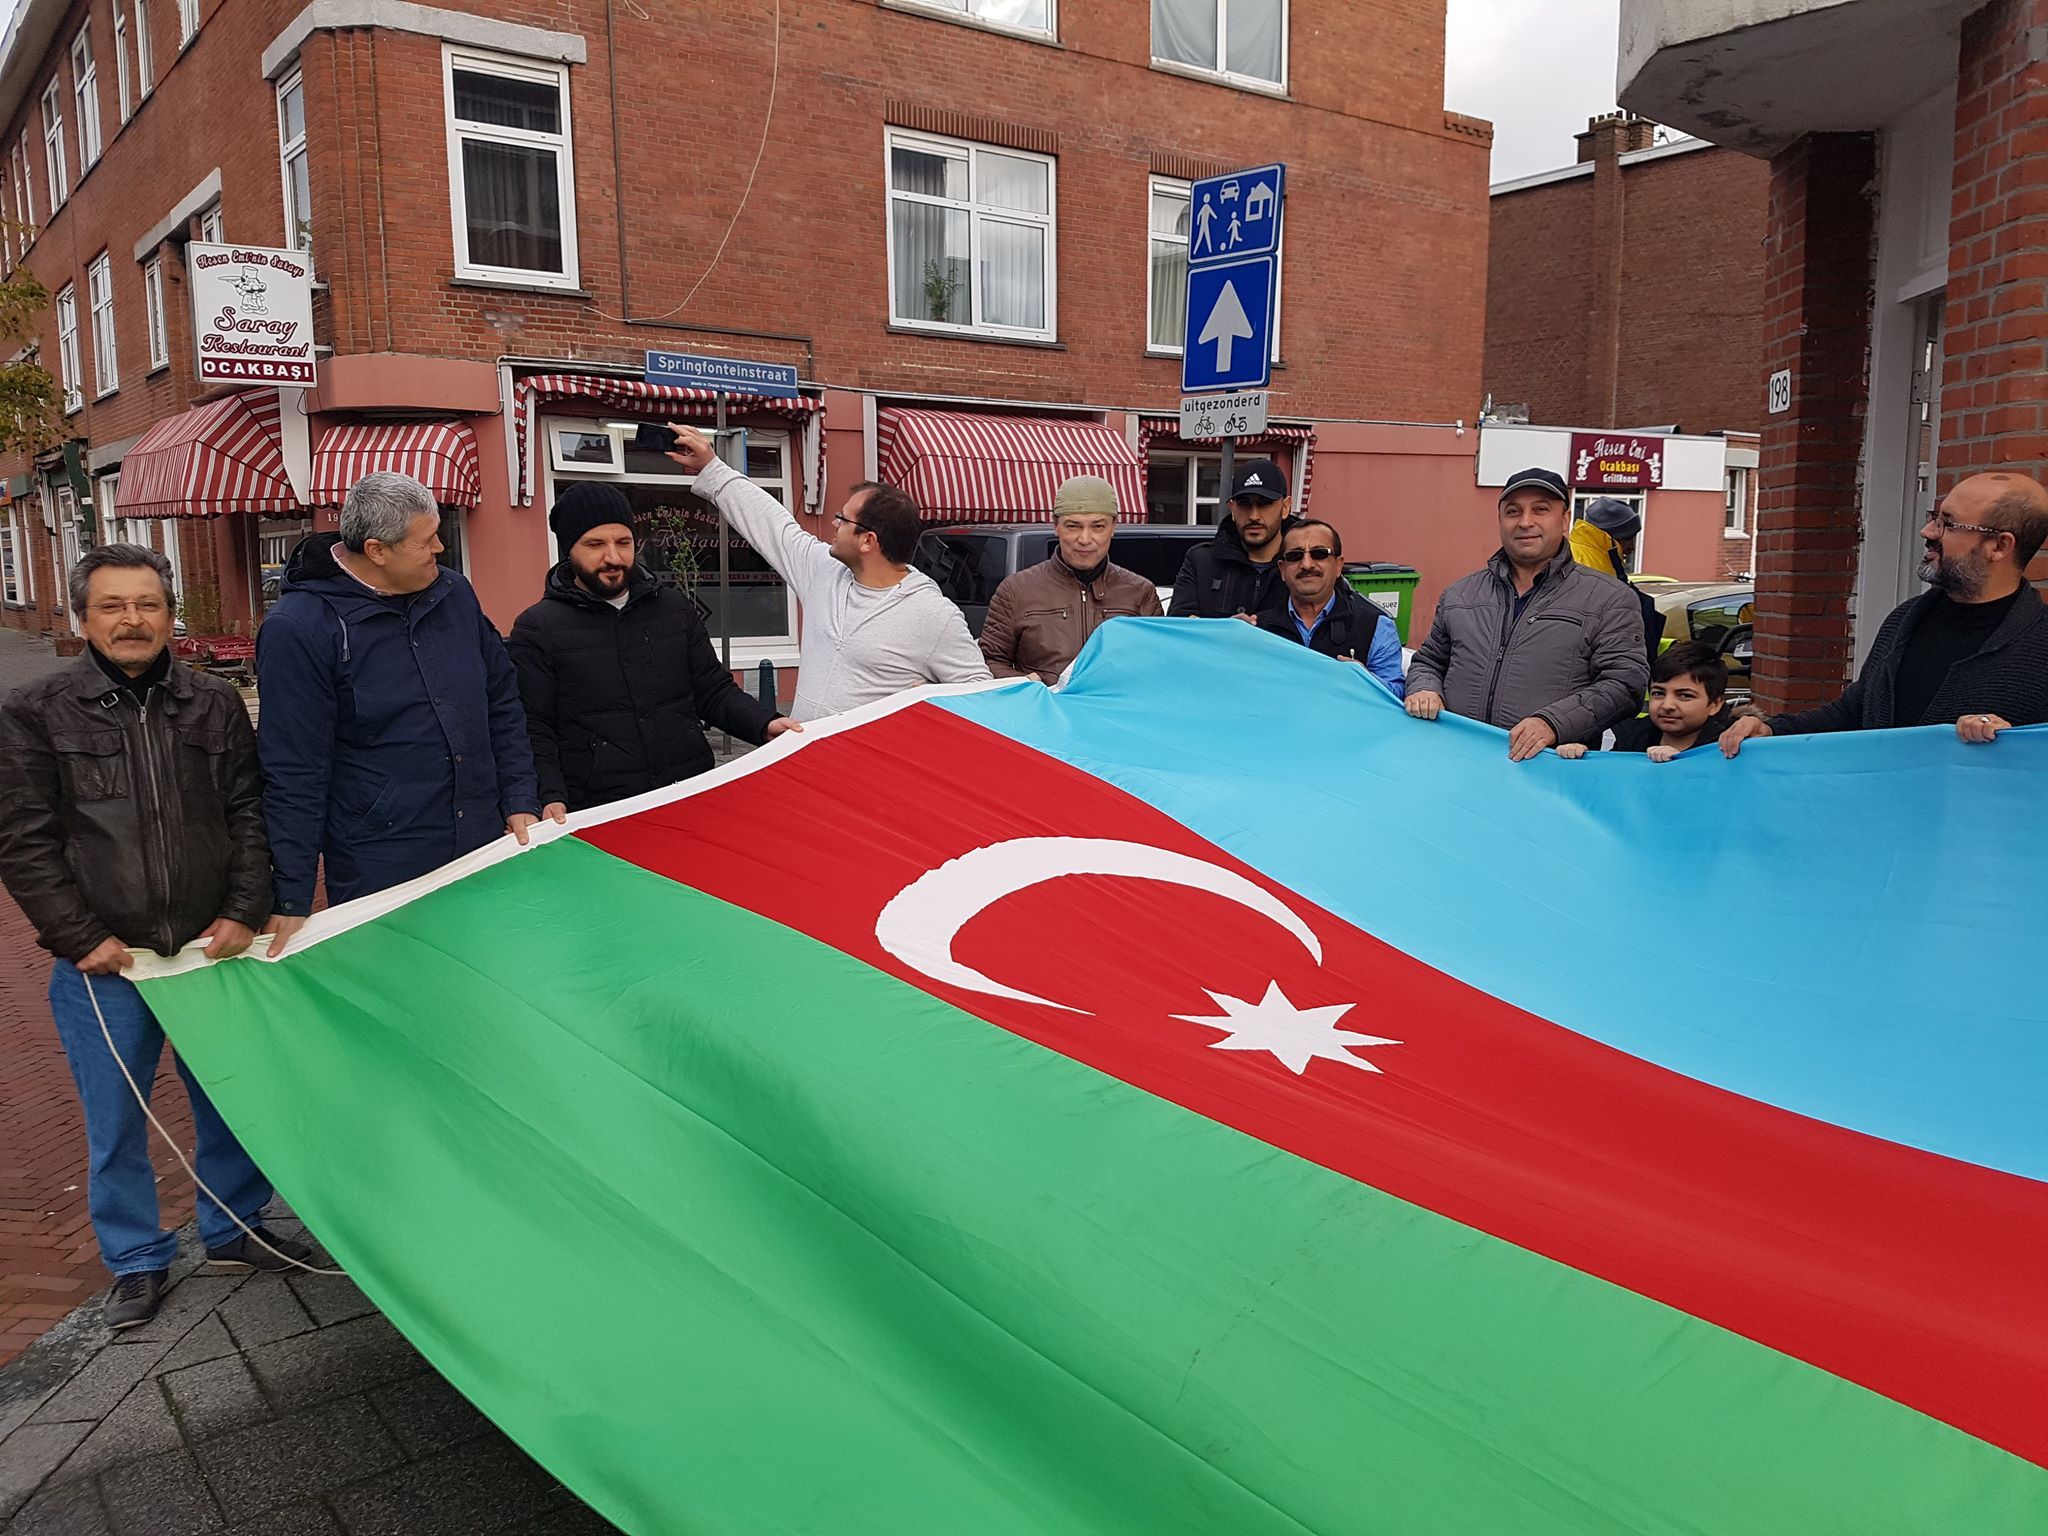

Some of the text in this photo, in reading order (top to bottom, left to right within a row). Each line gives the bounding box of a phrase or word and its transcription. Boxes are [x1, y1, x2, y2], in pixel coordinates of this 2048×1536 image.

[214, 306, 298, 344] Saray
[201, 334, 309, 357] Restaurant
[203, 361, 310, 380] OCAKBAŞI
[658, 356, 788, 382] Springfonteinstraat
[1184, 394, 1261, 414] uitgezonderd
[1771, 376, 1788, 409] 198
